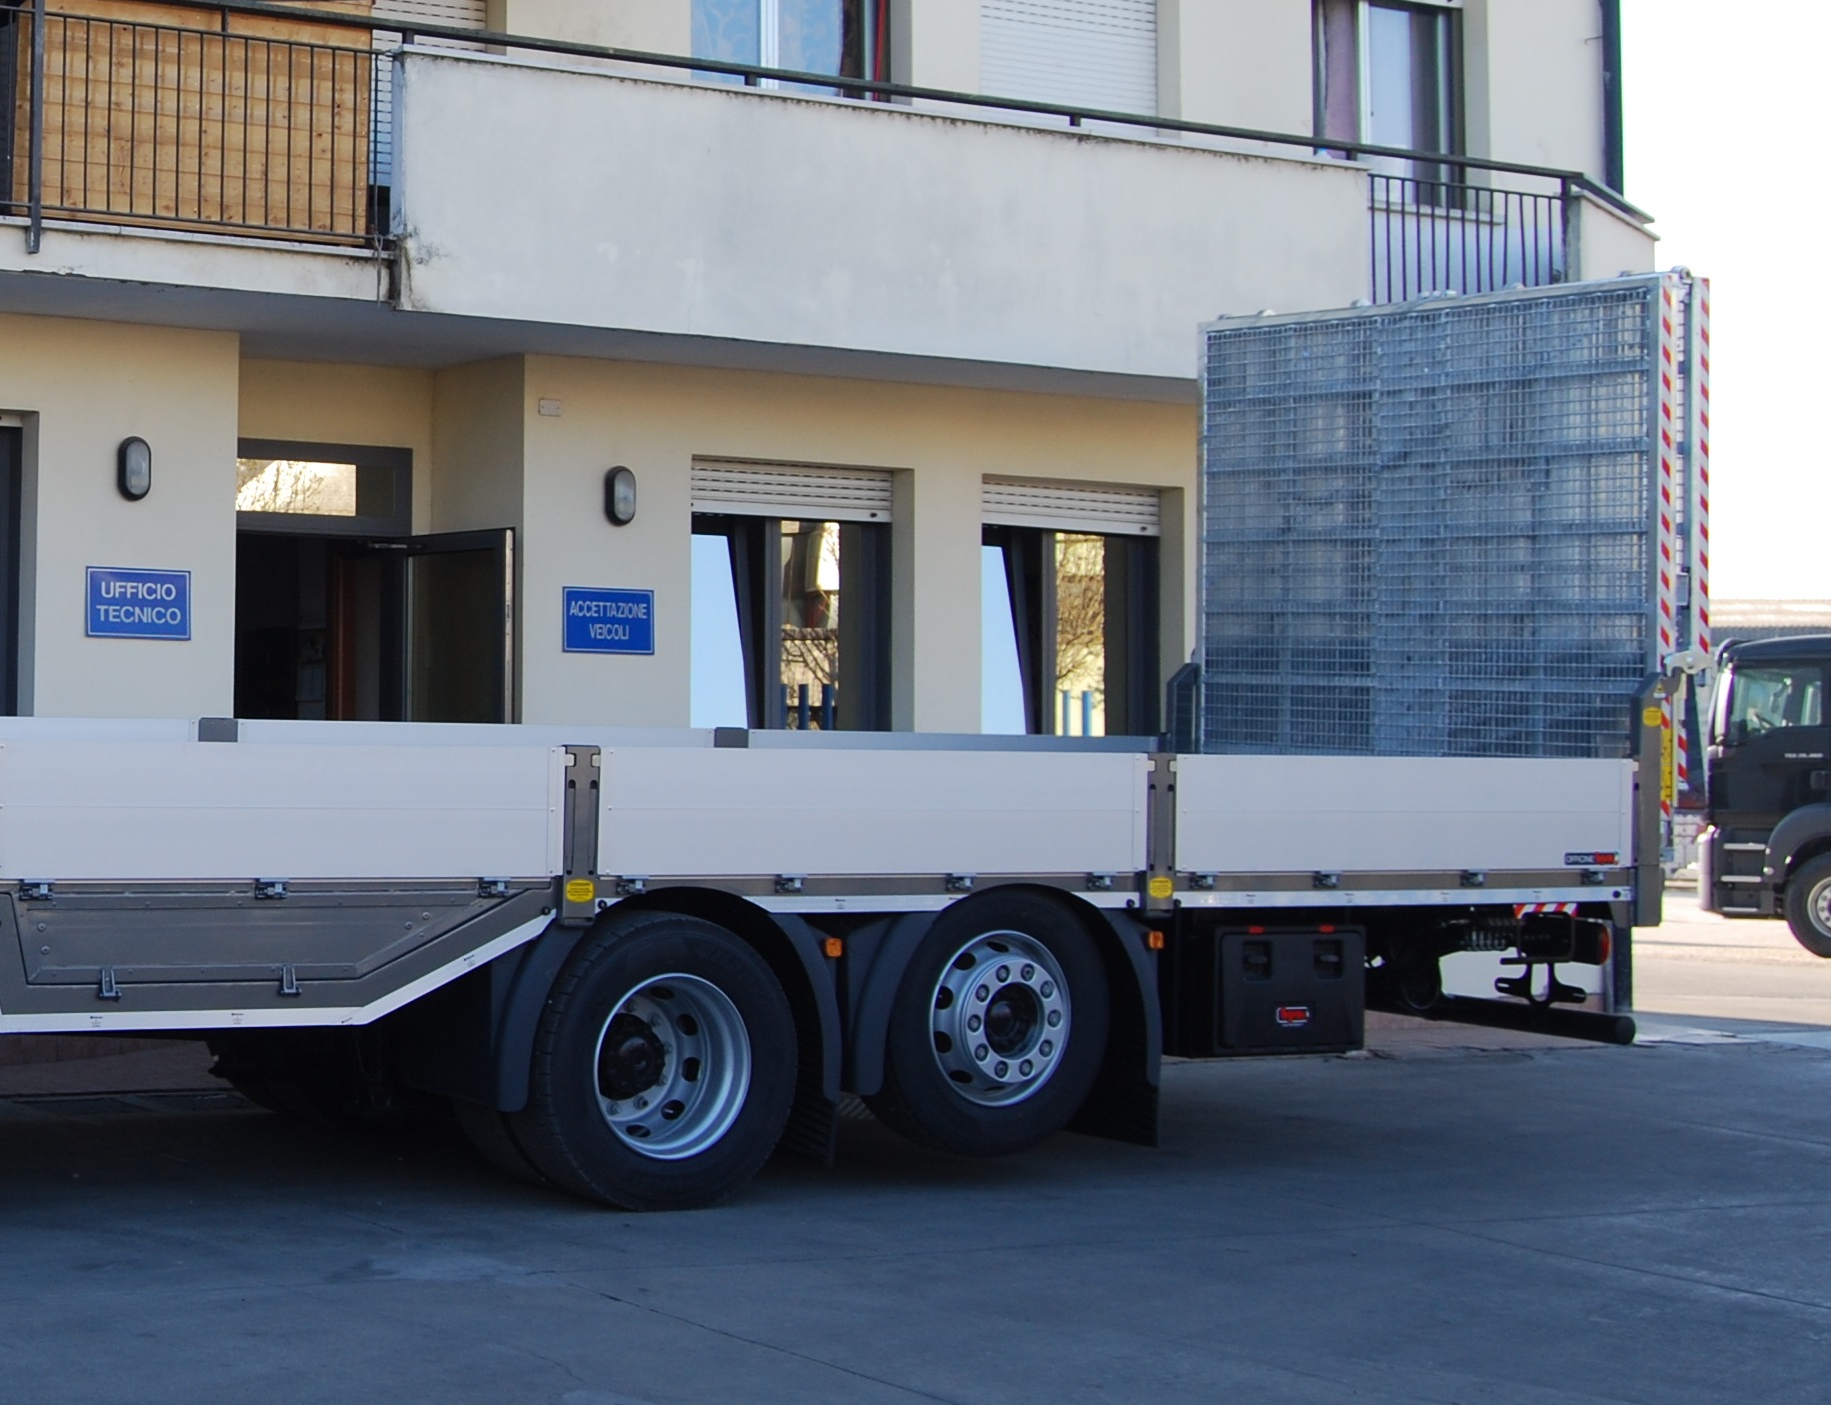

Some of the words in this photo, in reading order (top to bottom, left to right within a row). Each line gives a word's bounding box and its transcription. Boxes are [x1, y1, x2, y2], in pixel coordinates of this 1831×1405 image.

[101, 581, 176, 600] UFFICIO
[96, 605, 181, 624] TECNICO
[570, 600, 647, 618] ACCETTAZIONE
[589, 623, 629, 640] VEICOLI
